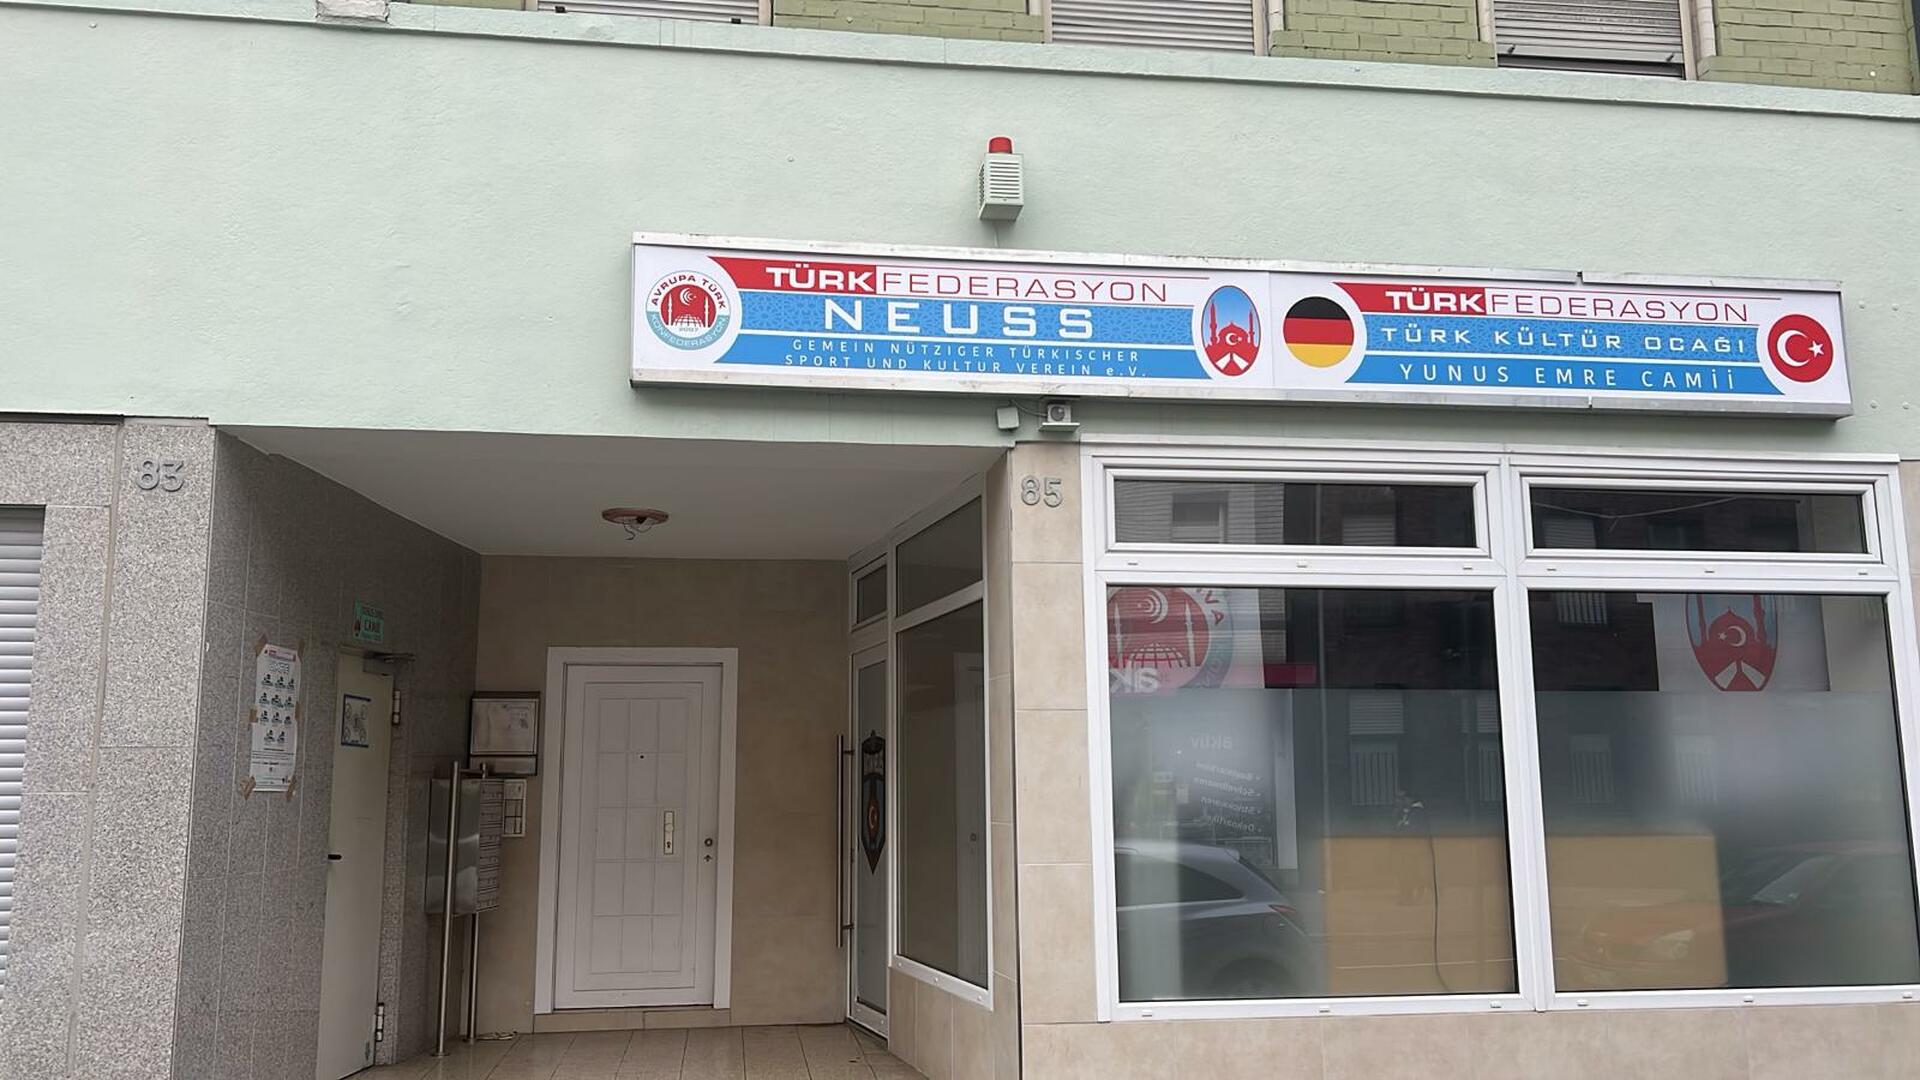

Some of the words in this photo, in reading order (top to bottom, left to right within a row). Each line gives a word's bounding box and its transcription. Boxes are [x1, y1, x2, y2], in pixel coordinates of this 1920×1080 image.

[651, 275, 696, 306] AVRUPA
[702, 278, 727, 309] TÜRK
[765, 263, 874, 292] TÜRK
[882, 272, 1167, 302] FEDERASYON
[824, 298, 1093, 339] NEUSS
[1385, 286, 1485, 313] TÜRK
[1491, 294, 1748, 322] FEDERASYON
[793, 339, 874, 354] GEMEIN
[890, 342, 994, 357] NÜTZIGER
[1009, 345, 1139, 362] TÜRKISCHER
[1381, 323, 1471, 344] TÜRK
[1495, 326, 1621, 349] KÜLTÜR
[1644, 335, 1745, 354] OCAĞI
[785, 354, 851, 367] SPORT
[867, 357, 907, 369] UND
[923, 359, 1001, 372] KULTUR
[1016, 362, 1091, 375] VEREIN
[1106, 366, 1147, 377] e.V.
[1400, 363, 1509, 383] YUNUS
[1535, 366, 1616, 386] EMRE
[134, 459, 185, 492] 83
[1020, 475, 1063, 508] 85
